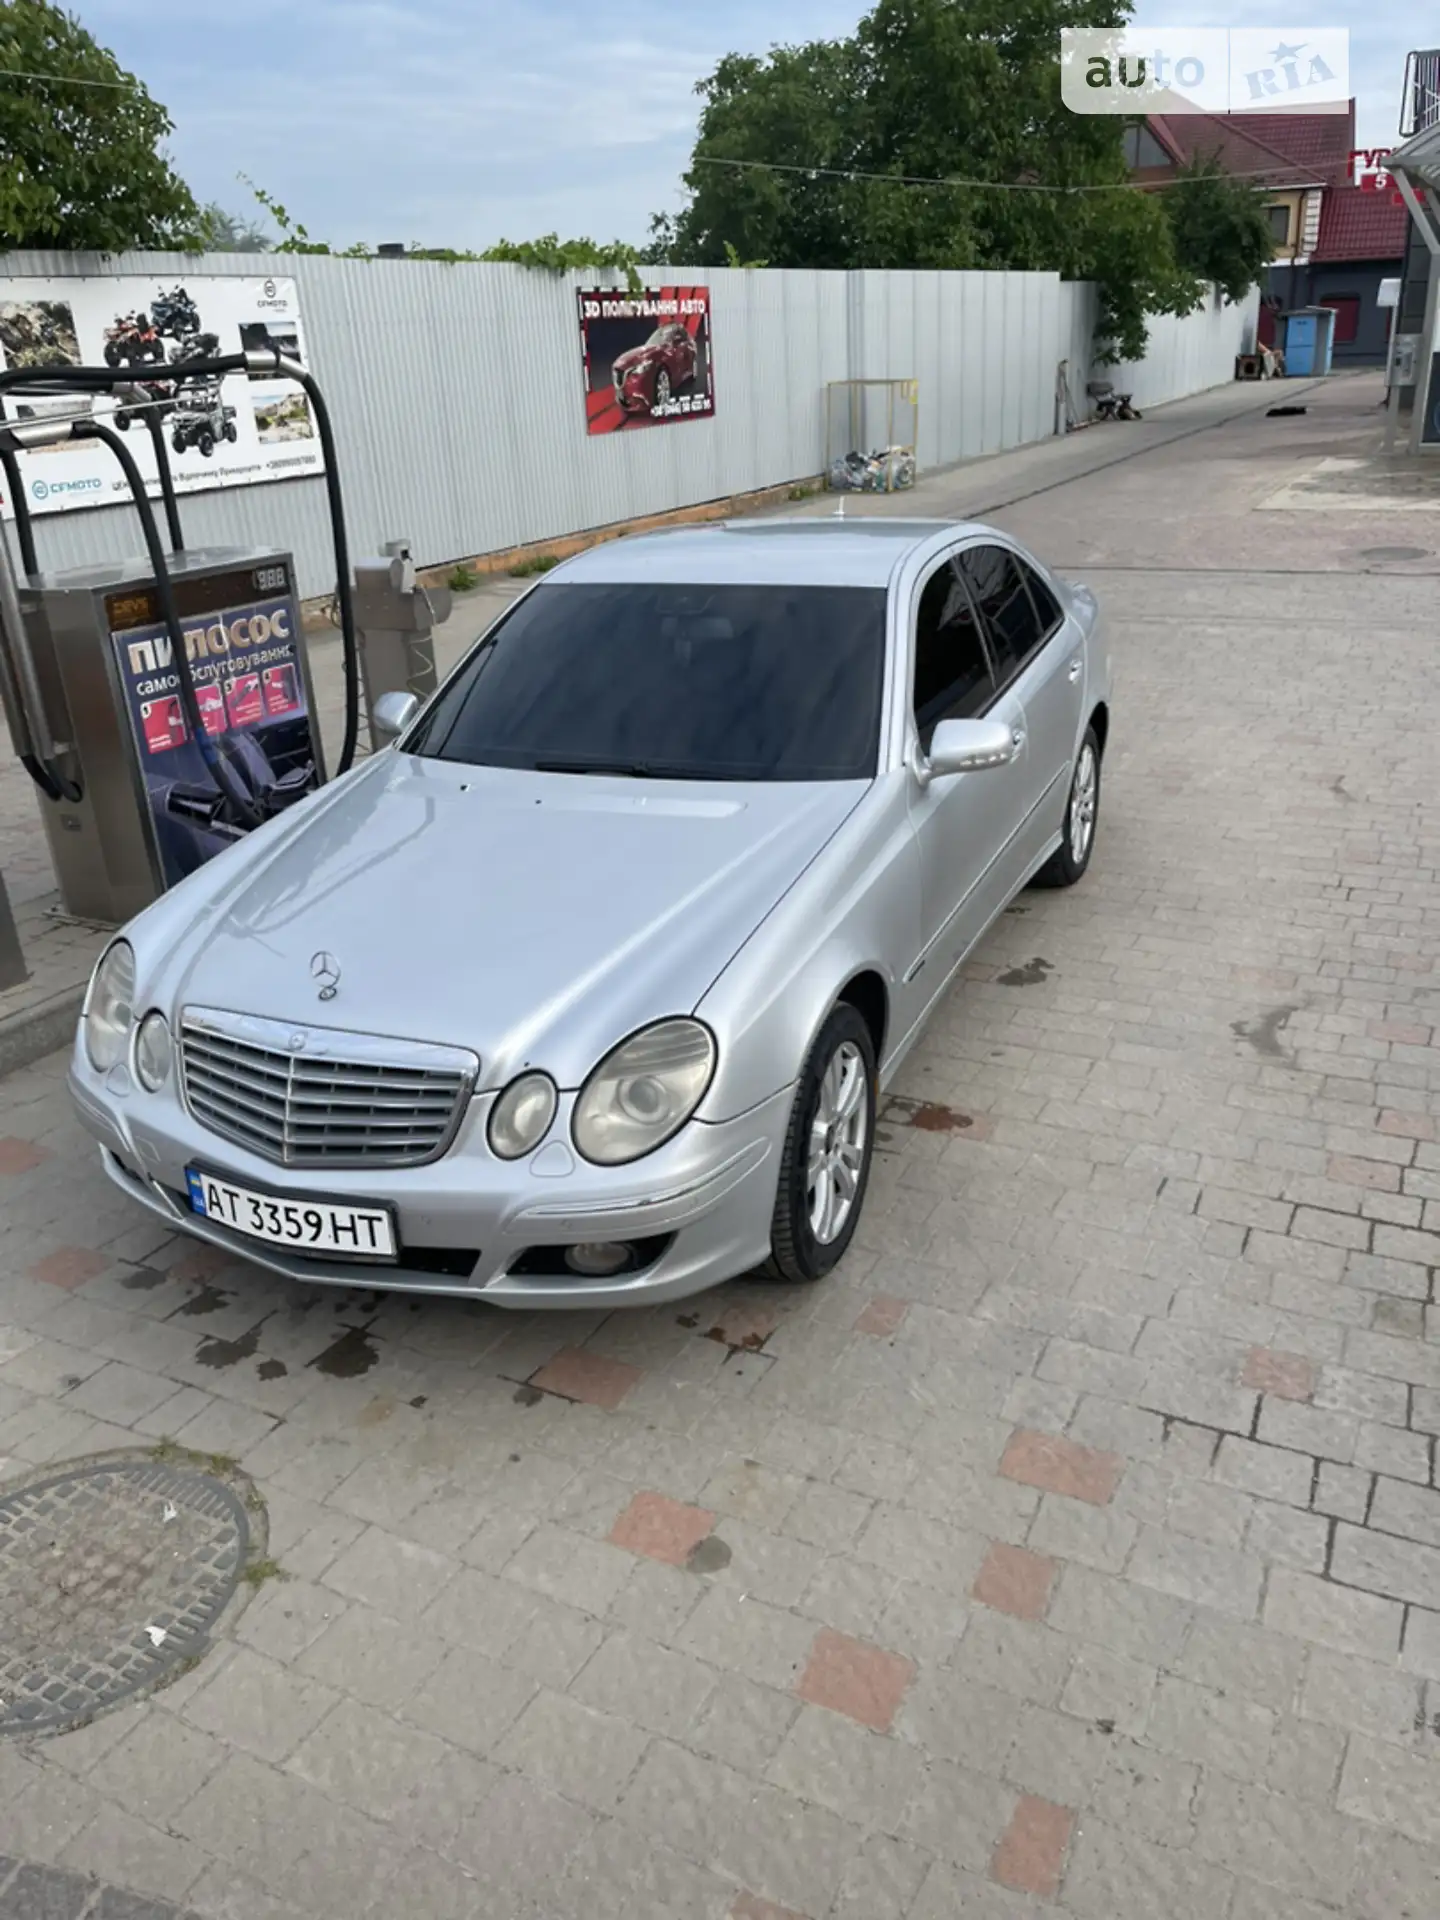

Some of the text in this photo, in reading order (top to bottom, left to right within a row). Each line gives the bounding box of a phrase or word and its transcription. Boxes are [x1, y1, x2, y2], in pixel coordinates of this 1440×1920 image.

[680, 299, 706, 314] АВТО
[50, 478, 102, 493] CFMOTO
[128, 609, 290, 675] ПИЛОСОС
[208, 1184, 382, 1248] AT 3359 HT
